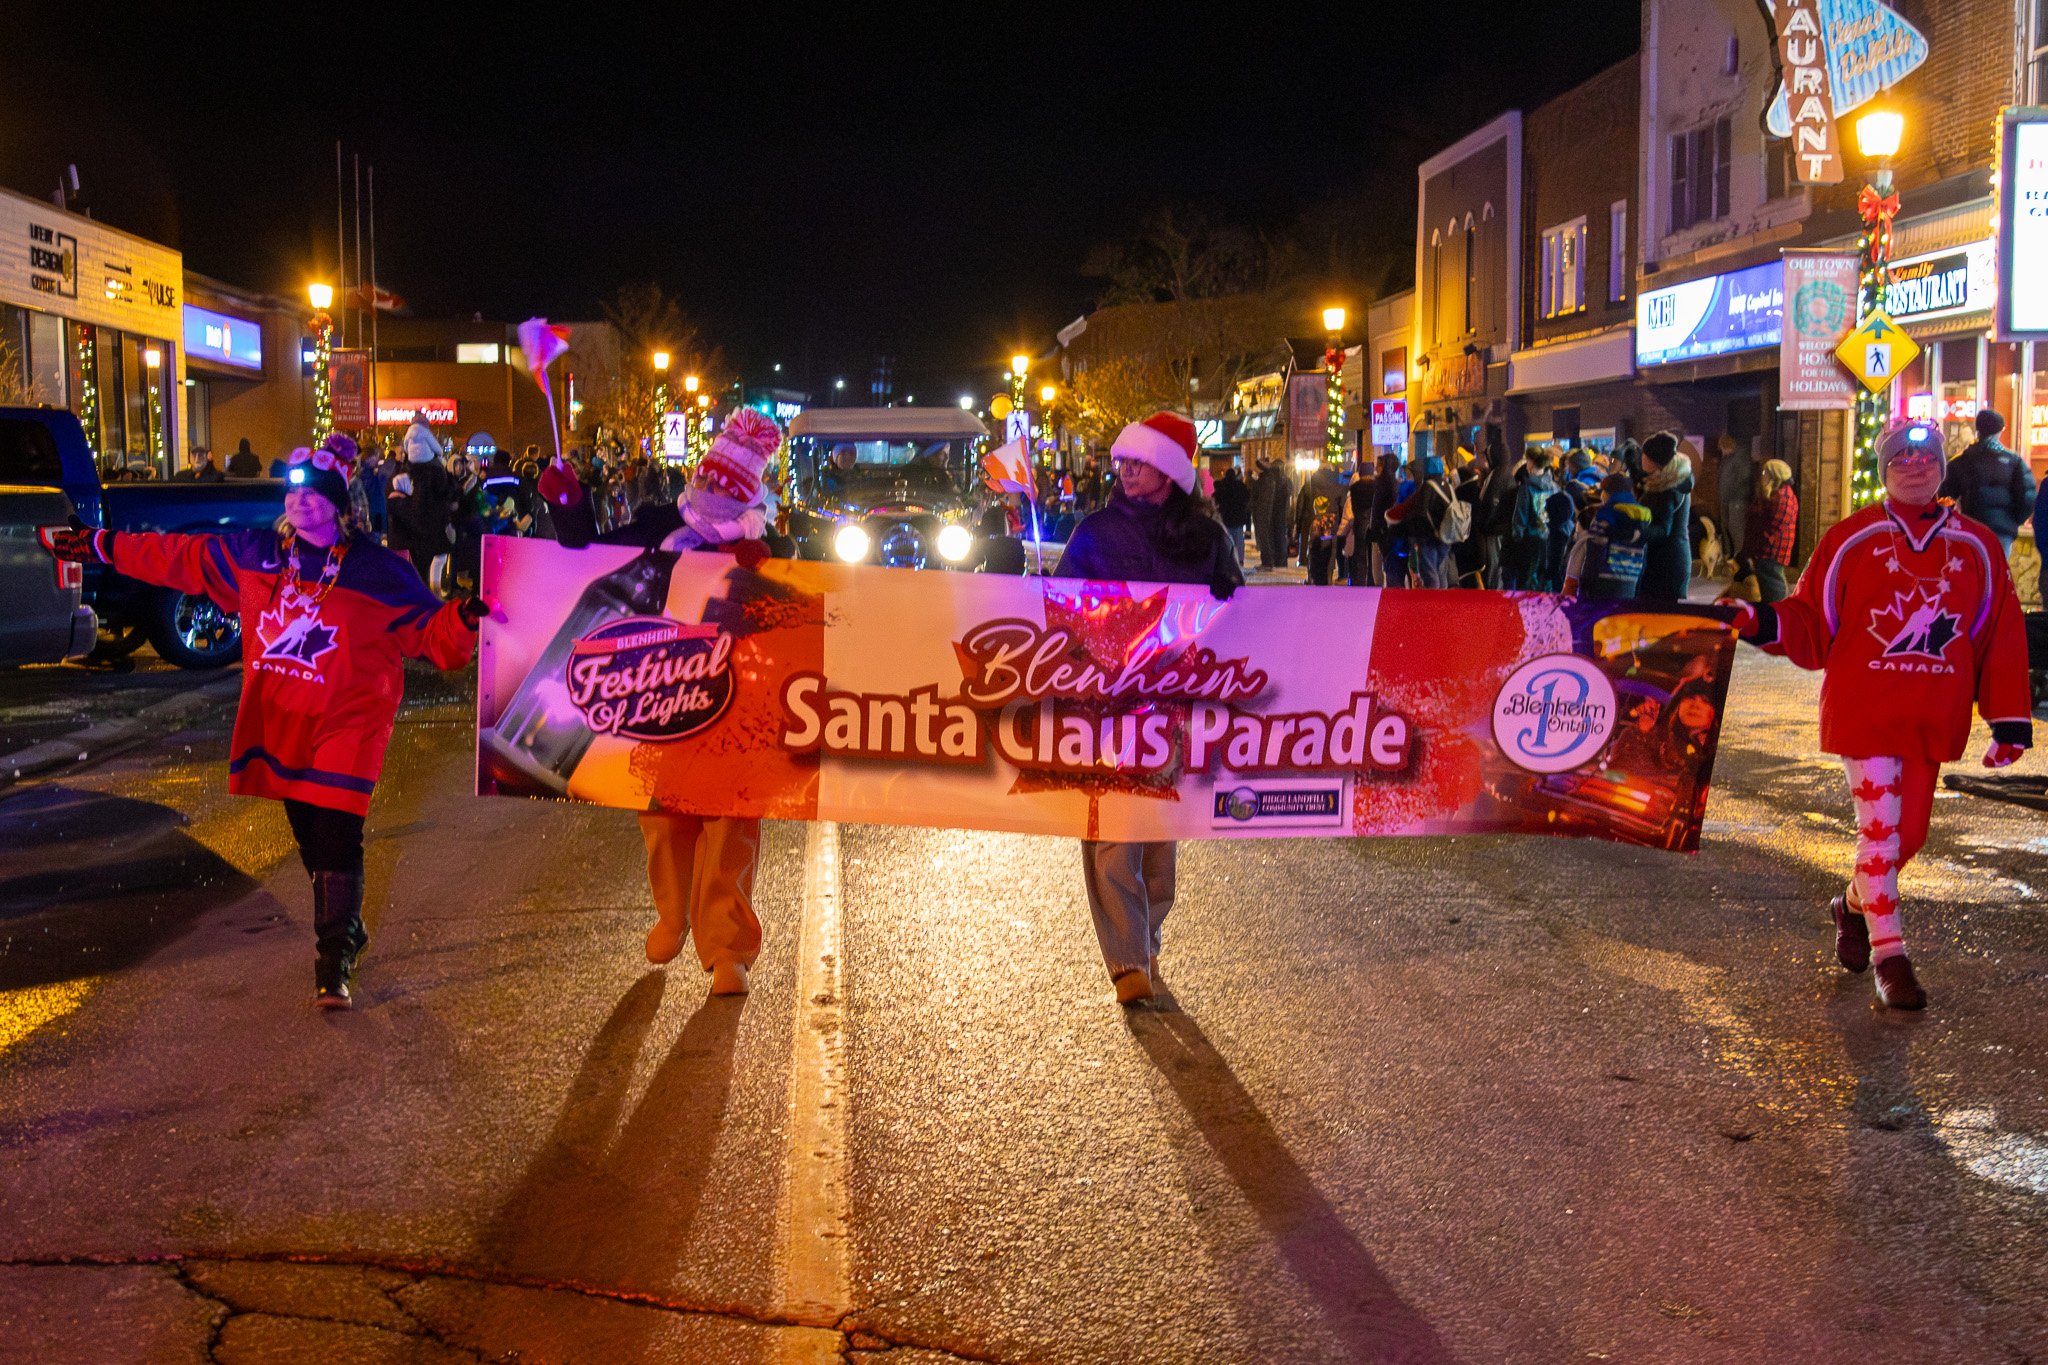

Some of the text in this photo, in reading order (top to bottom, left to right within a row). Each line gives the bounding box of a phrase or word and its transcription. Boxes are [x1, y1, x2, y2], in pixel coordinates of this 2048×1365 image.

[1829, 10, 1882, 50] Venus
[1783, 0, 1832, 181] AURANT
[1789, 258, 1855, 271] OUR TOWN
[1885, 268, 1967, 316] RESTAURANT
[1789, 379, 1847, 393] HOLIDAYS
[1375, 412, 1404, 424] PASSING
[1384, 402, 1394, 413] NO
[617, 627, 679, 650] BLENHEIM
[252, 660, 325, 684] CANADA
[571, 631, 733, 706] Festival
[968, 623, 1261, 702] Blenheim
[1867, 660, 1955, 673] CANADA
[587, 683, 714, 735] Of Lights
[1503, 693, 1606, 719] Blenheim
[784, 676, 1406, 768] Santa Claus Parade
[1547, 716, 1604, 735] Ontario
[1288, 794, 1325, 803] LANDFILL
